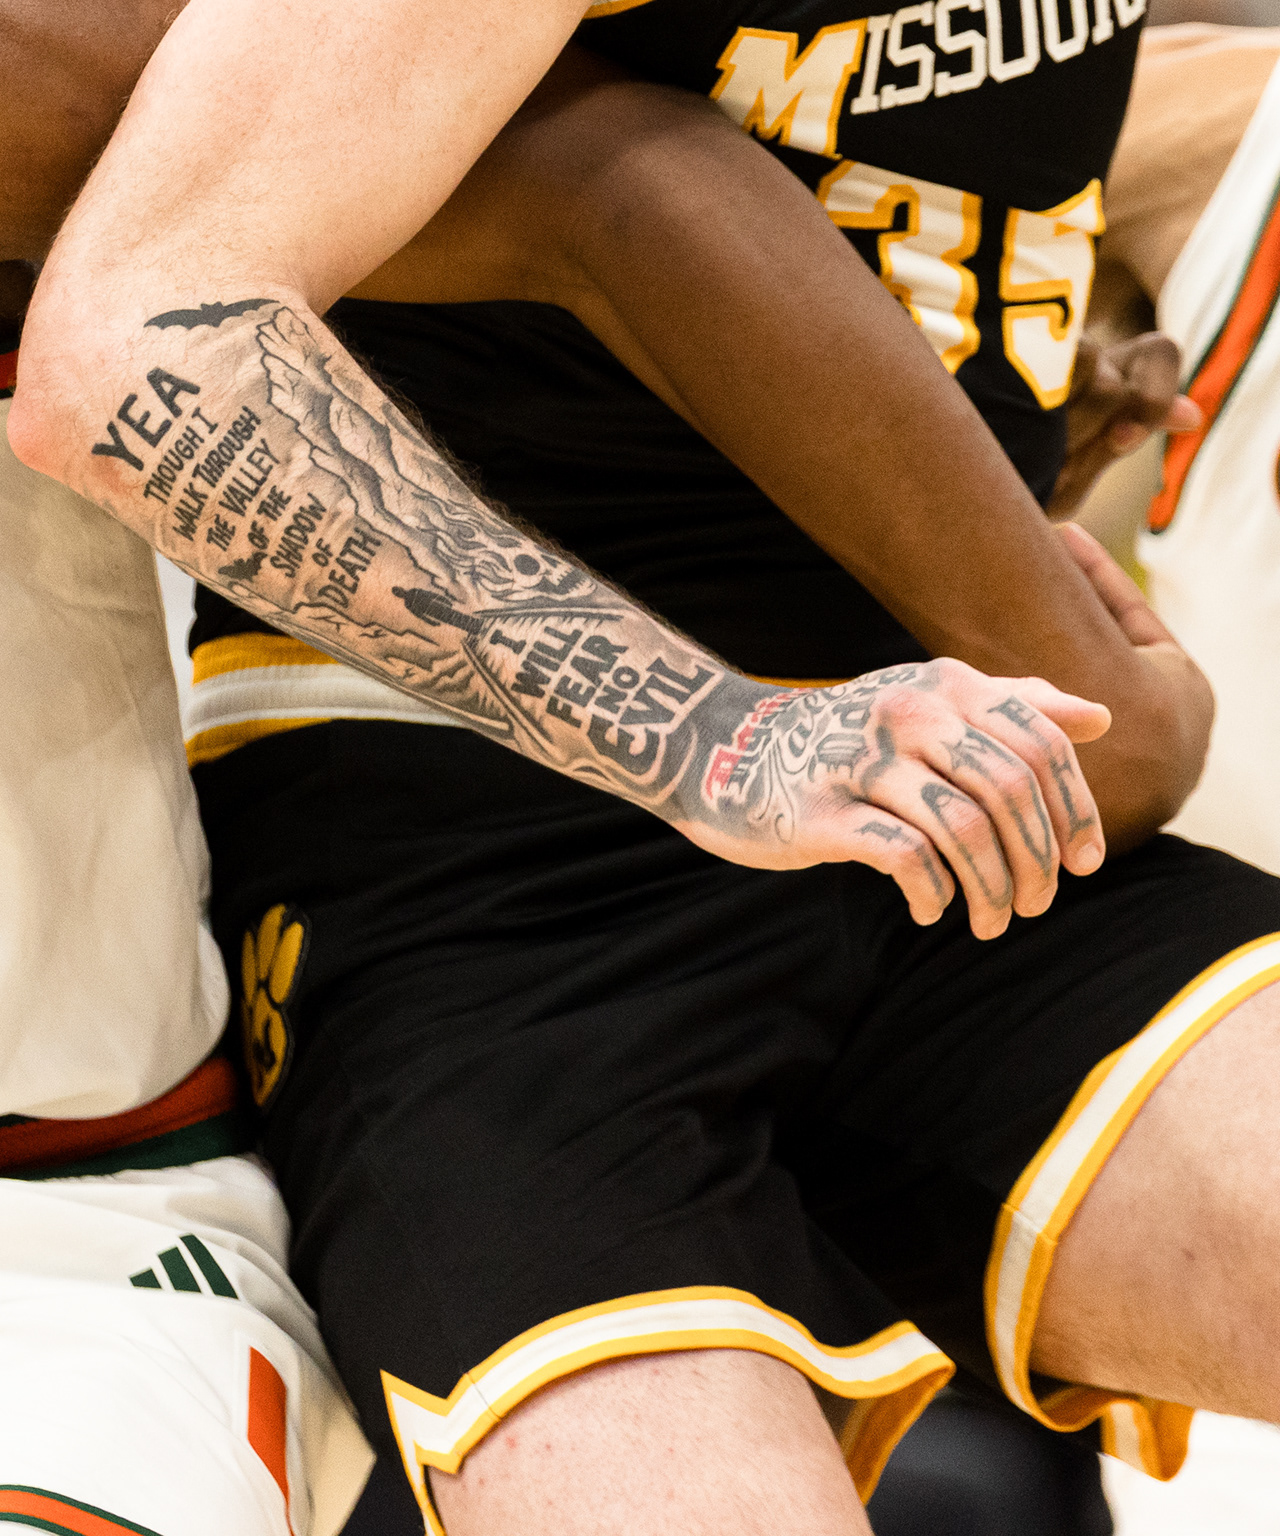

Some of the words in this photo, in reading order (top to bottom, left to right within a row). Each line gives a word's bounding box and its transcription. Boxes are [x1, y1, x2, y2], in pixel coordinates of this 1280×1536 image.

[816, 177, 1107, 411] 35
[91, 367, 201, 472] YEA
[143, 425, 205, 505] THOUGH
[192, 407, 219, 434] I
[172, 482, 208, 542] WALK
[191, 405, 261, 488] THROUGH
[219, 438, 280, 517] VALLEY
[256, 485, 292, 521] THE
[206, 514, 236, 551] THE
[247, 520, 270, 550] OF
[270, 492, 326, 578] SHADOW
[312, 538, 333, 567] OF
[318, 527, 382, 609] DEATH
[490, 629, 527, 655] I
[511, 626, 583, 699] WILL
[545, 635, 629, 728] FEAR
[587, 656, 716, 773] EVIL
[594, 666, 640, 714] NO
